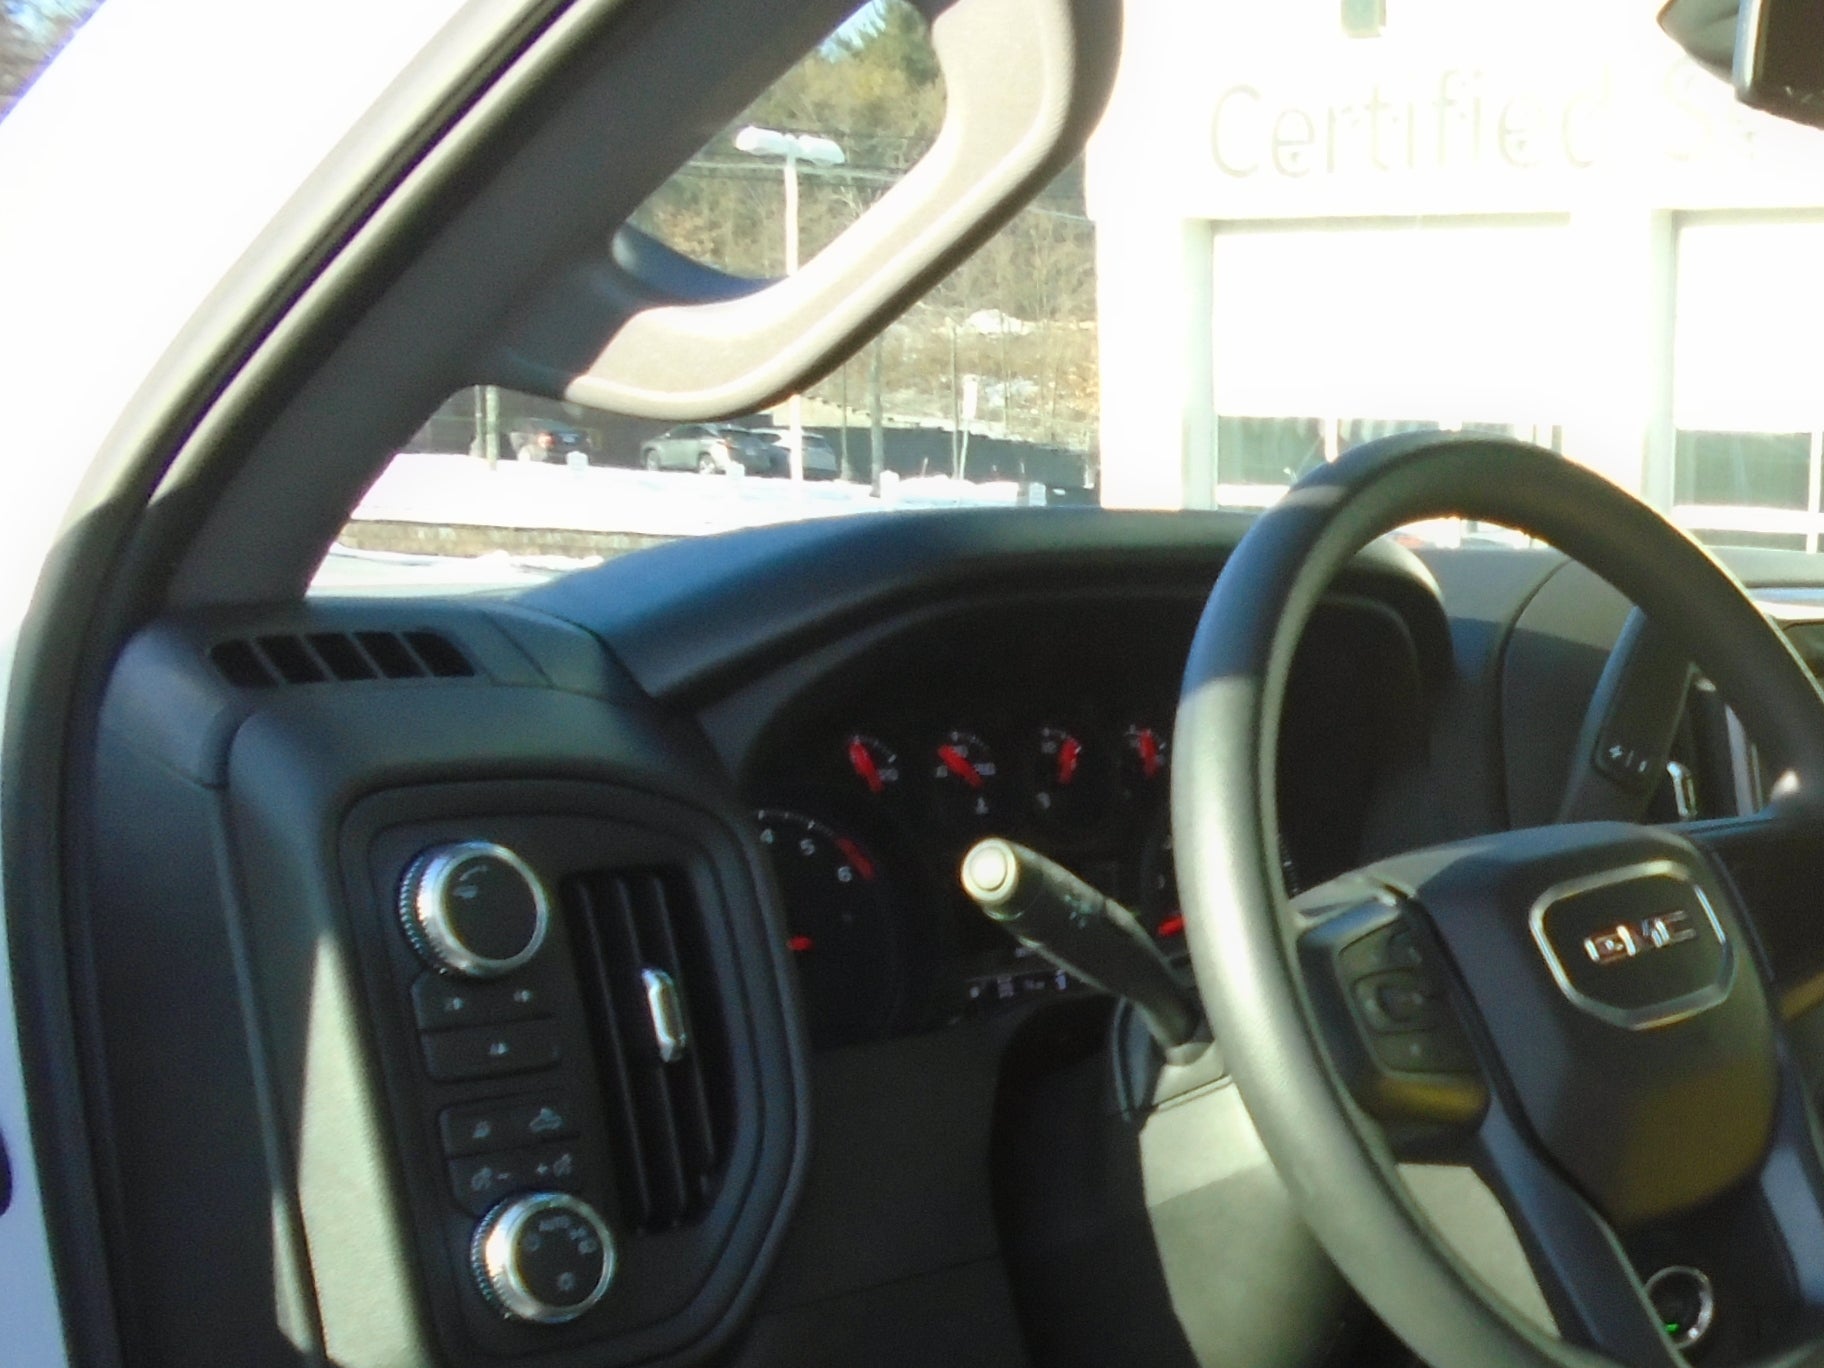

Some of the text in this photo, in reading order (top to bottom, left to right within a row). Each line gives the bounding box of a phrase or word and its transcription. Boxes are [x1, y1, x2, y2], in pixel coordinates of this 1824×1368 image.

[1210, 64, 1612, 178] Certified
[800, 838, 815, 856] 5
[837, 866, 852, 883] 6
[1584, 910, 1696, 964] GMC
